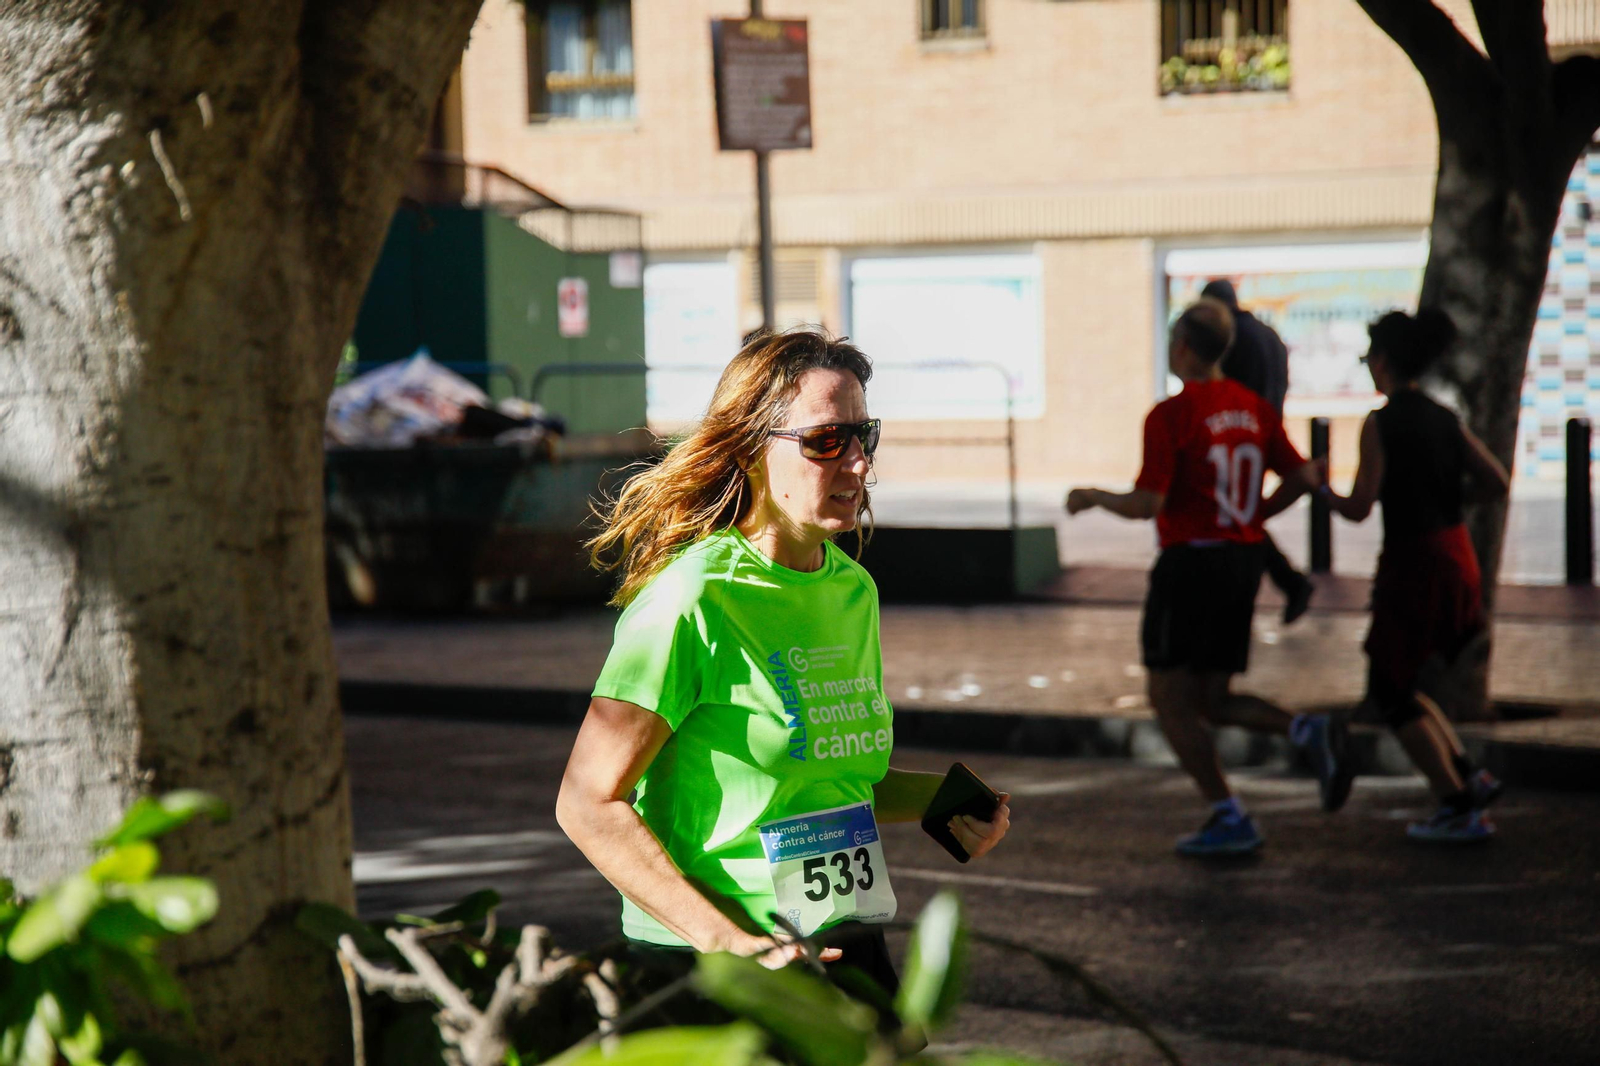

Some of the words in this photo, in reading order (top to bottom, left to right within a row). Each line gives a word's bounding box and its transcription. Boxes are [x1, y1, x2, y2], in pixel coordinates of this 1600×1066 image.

[1206, 443, 1263, 527] 10
[768, 650, 807, 762] ALMERÍA
[796, 678, 822, 699] En
[823, 676, 877, 697] marcha
[808, 699, 870, 724] contra
[871, 693, 889, 716] el
[773, 837, 805, 850] contra
[808, 833, 817, 842] el
[819, 830, 845, 841] cáncer
[803, 847, 874, 902] 533
